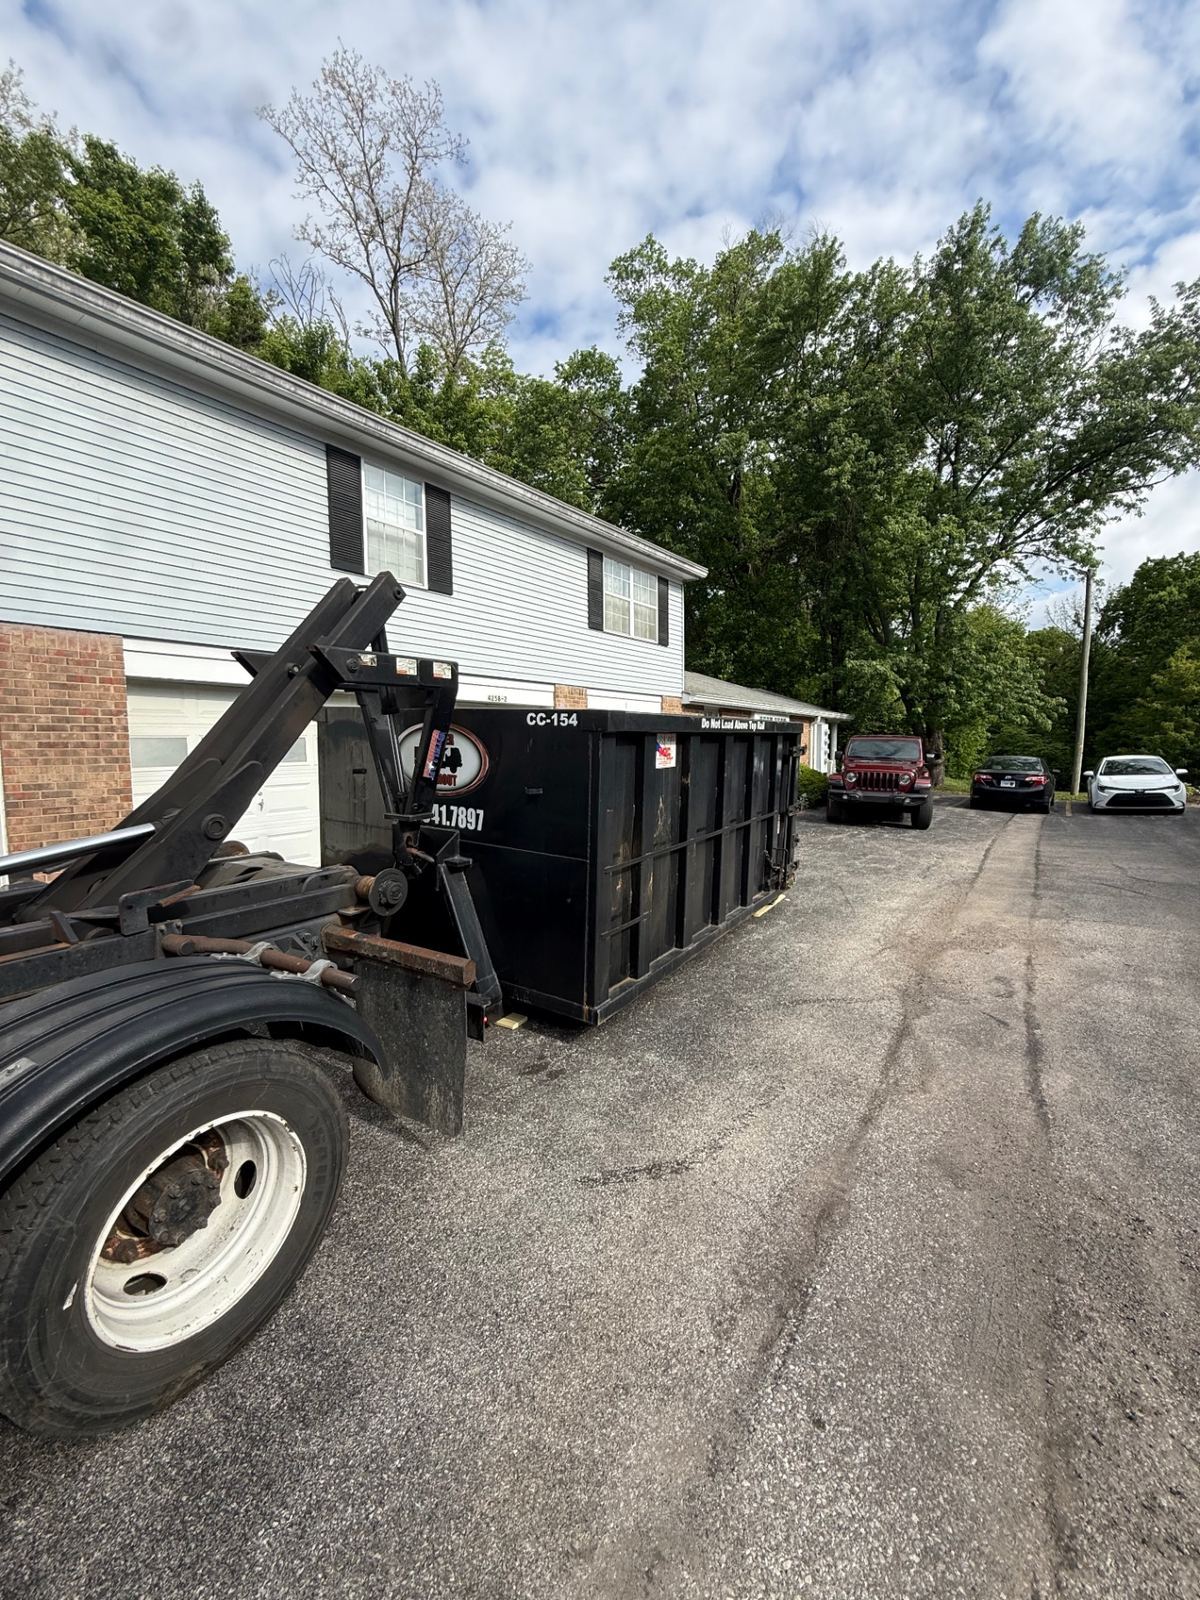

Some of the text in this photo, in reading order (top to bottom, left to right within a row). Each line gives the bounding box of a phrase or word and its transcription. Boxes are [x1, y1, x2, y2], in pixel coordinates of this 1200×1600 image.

[526, 712, 578, 727] CC-154
[701, 718, 709, 728] Do
[710, 718, 720, 729] Not
[721, 719, 733, 729] Load
[749, 720, 757, 732] Top
[423, 803, 484, 831] 41.7897
